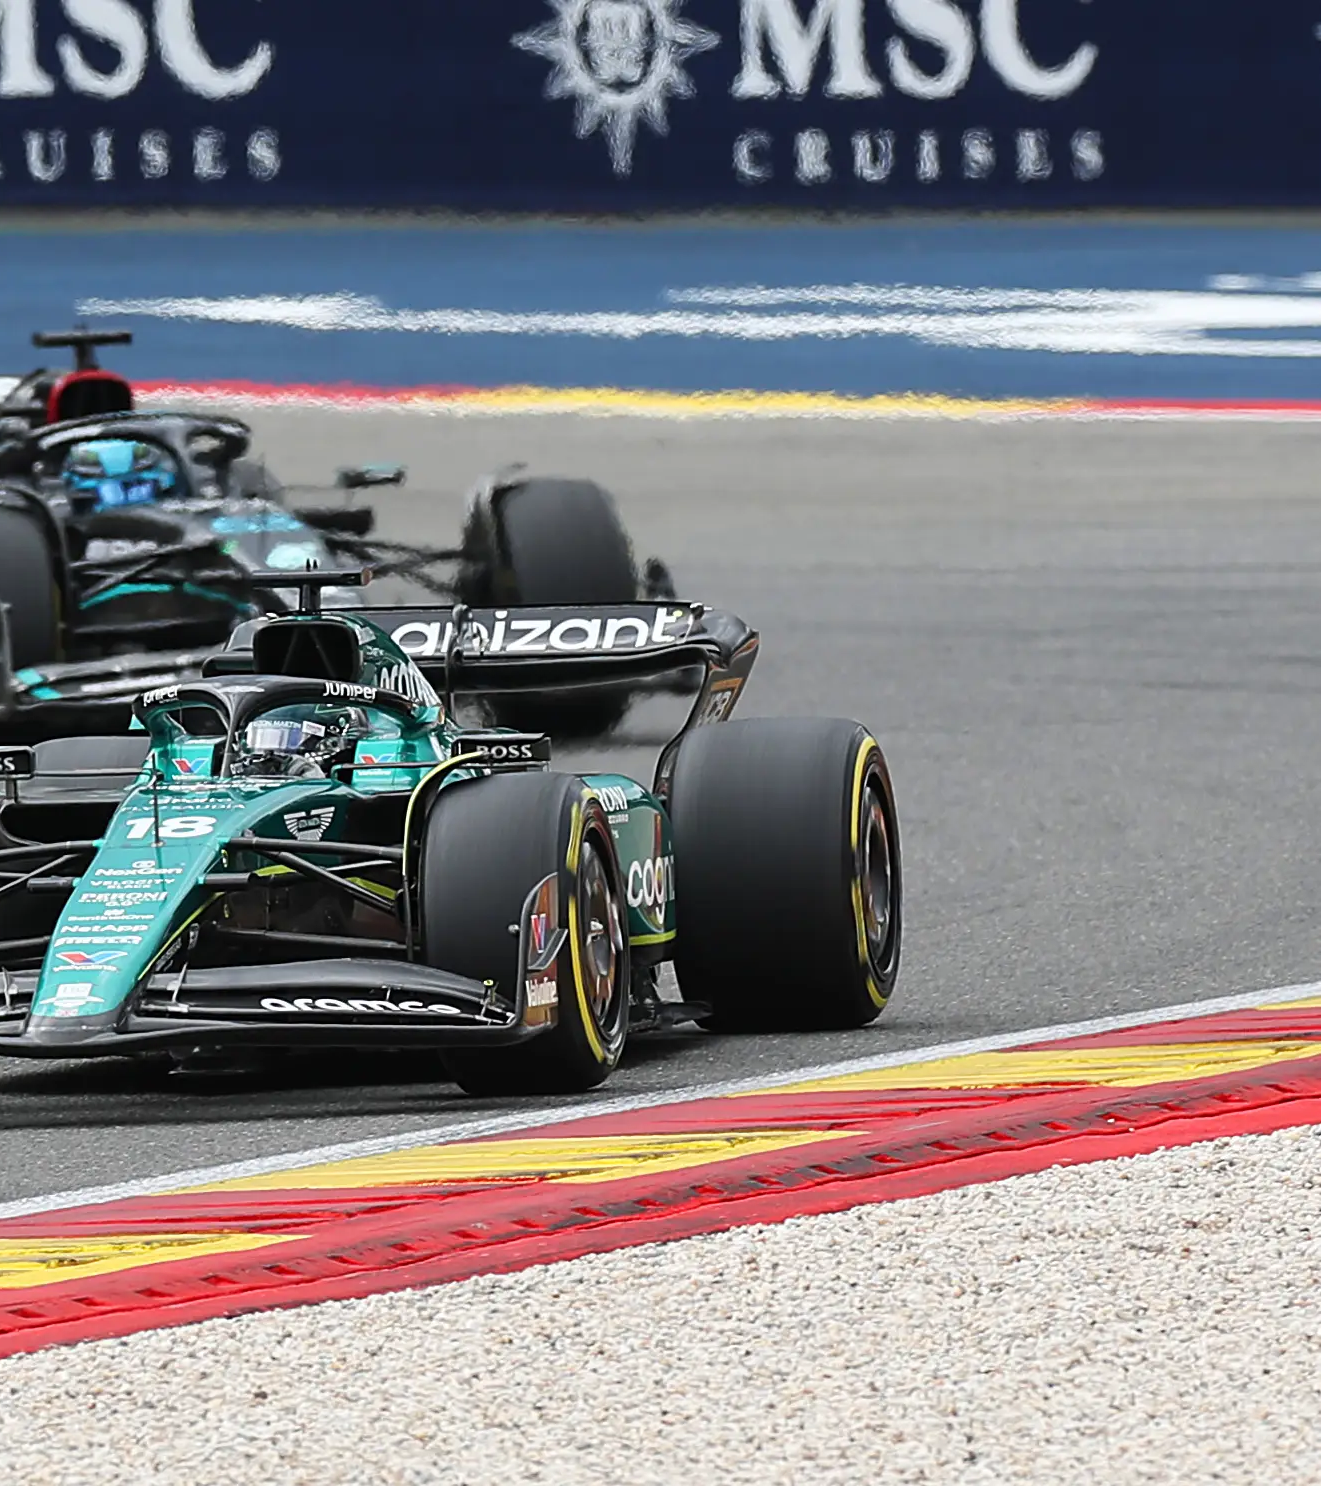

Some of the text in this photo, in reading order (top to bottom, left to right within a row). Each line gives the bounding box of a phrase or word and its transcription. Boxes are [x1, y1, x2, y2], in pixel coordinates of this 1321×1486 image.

[730, 0, 1097, 99] MSC
[732, 128, 1105, 183] CRUISES
[126, 816, 217, 839] 18
[95, 868, 183, 876] NexGen
[80, 892, 168, 900] PERONI
[60, 925, 150, 934] NetApp
[260, 997, 462, 1015] aramco
